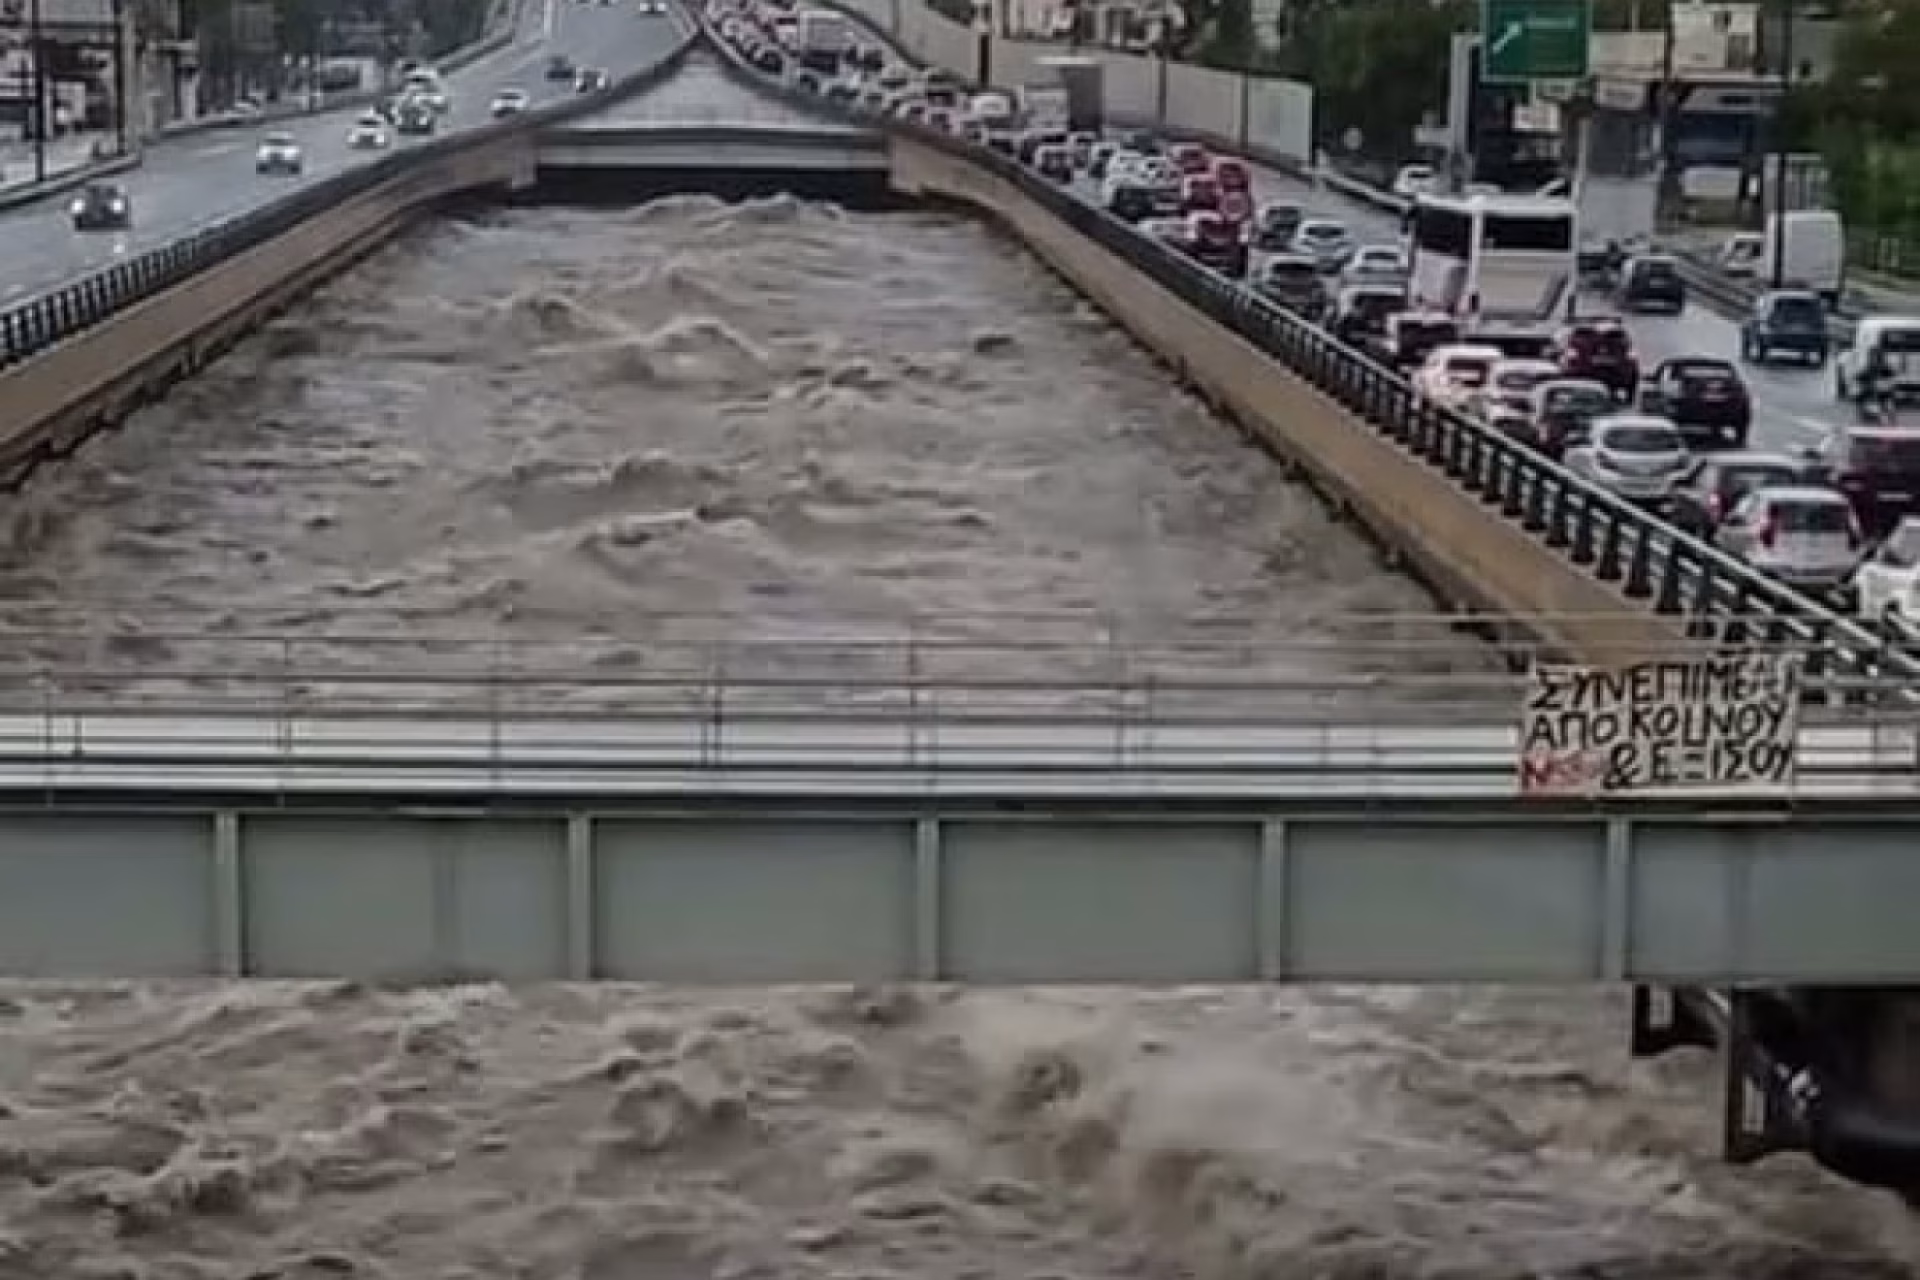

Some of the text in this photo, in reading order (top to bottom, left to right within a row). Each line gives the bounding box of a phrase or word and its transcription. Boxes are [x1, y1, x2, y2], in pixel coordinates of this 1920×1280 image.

[1526, 698, 1788, 750] ΑΠΟ ΚΟΙΝΟΥ
[1603, 743, 1640, 790] &
[1652, 738, 1793, 781] ΕΞΙΣΟΥ
